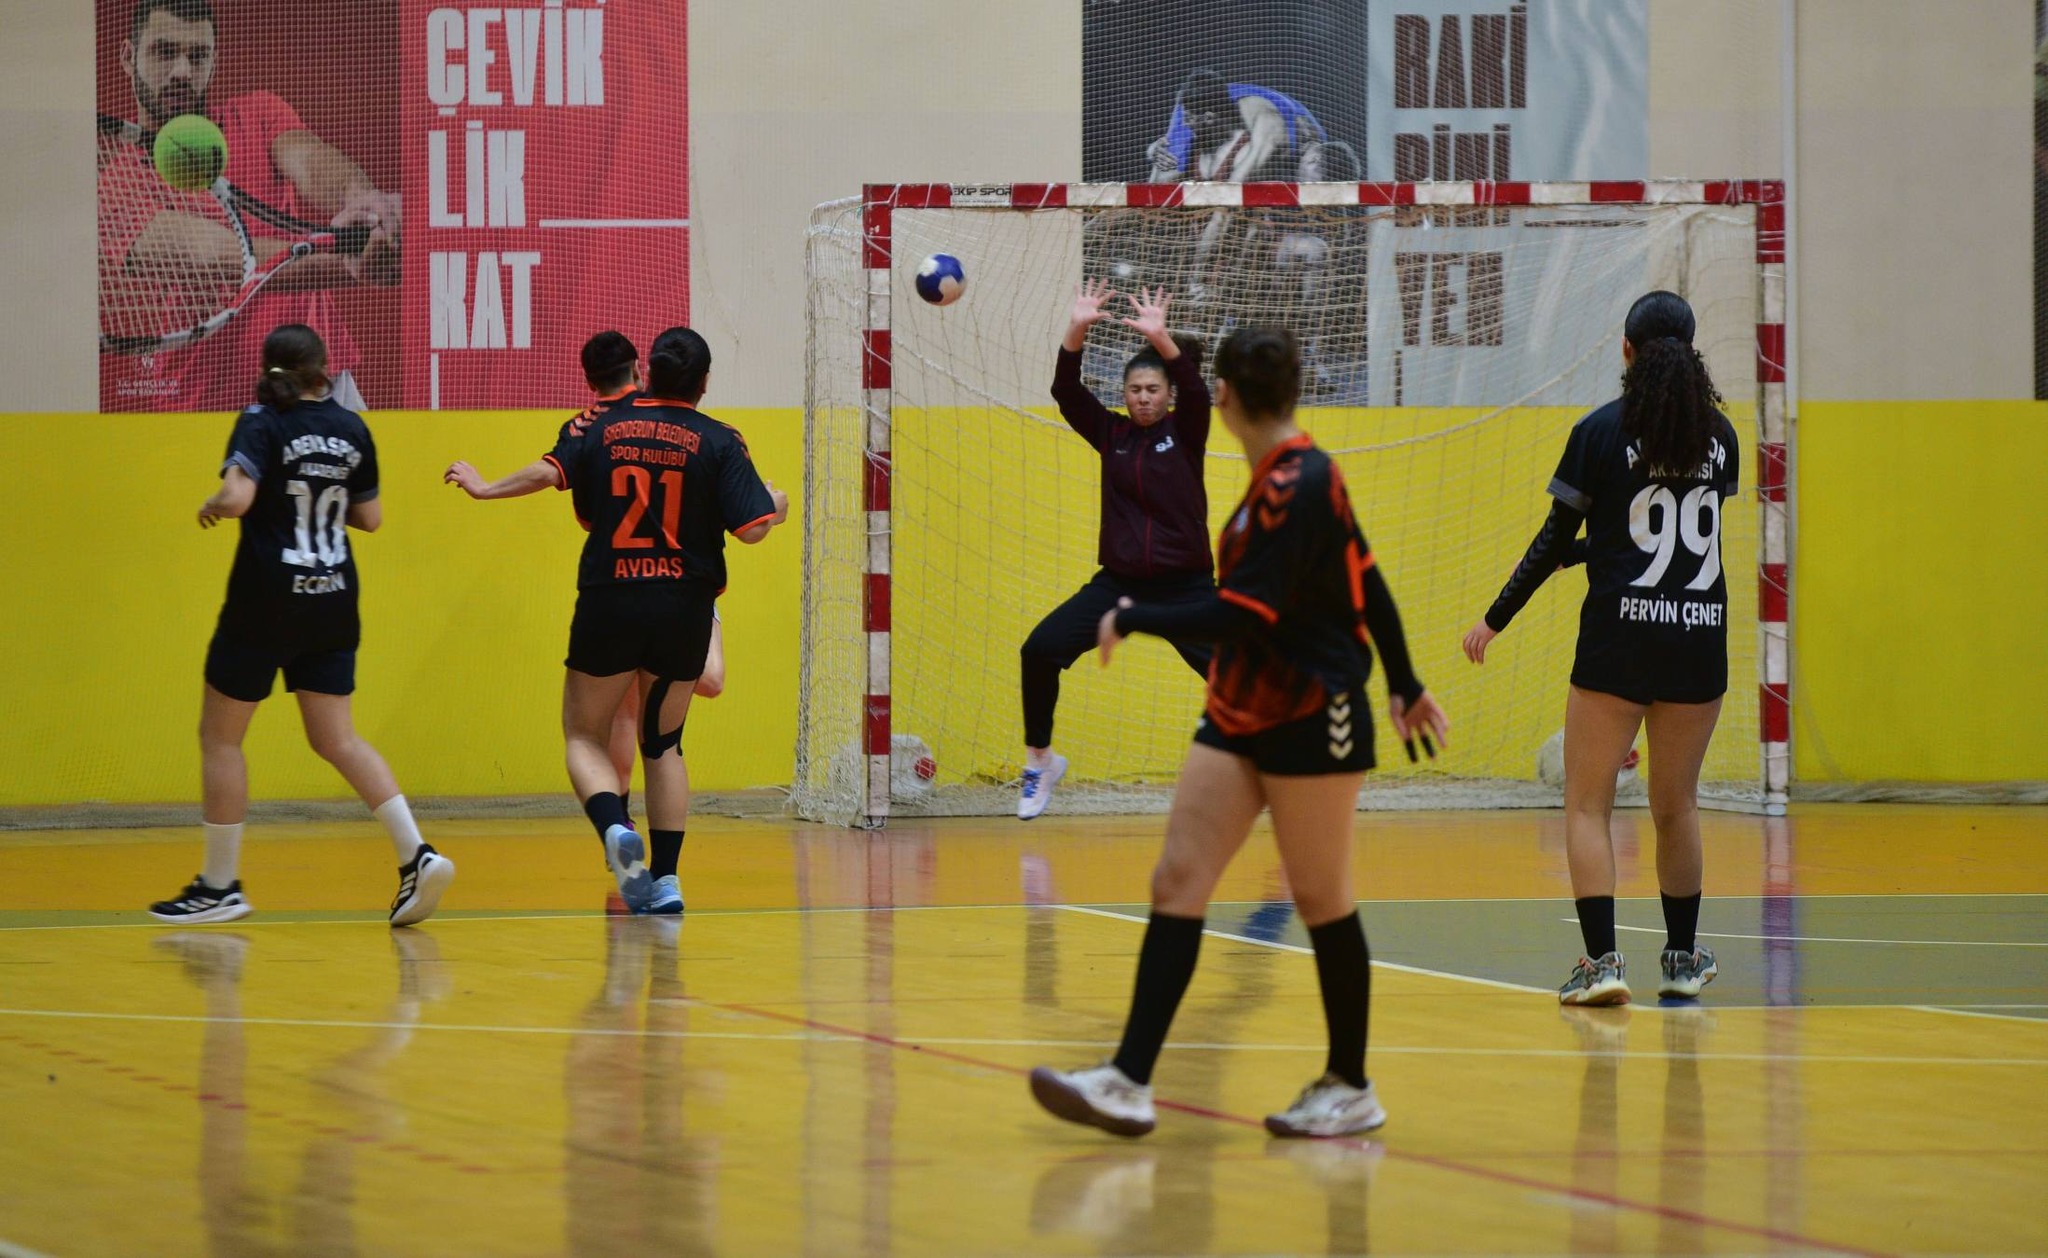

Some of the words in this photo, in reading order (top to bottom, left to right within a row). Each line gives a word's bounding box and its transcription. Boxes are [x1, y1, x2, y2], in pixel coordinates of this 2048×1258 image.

[427, 0, 604, 115] ÇEVİK
[1394, 6, 1528, 109] RAKİ
[428, 121, 526, 228] LİK
[979, 187, 1011, 196] SPOR
[430, 251, 541, 349] KAT
[1395, 252, 1503, 346] YEN
[603, 420, 657, 447] İSKENDERUN
[655, 422, 702, 455] BELEDİYESİ
[611, 445, 640, 461] SPOR
[642, 447, 687, 467] KULÜBÜ
[281, 479, 349, 568] 10
[611, 465, 684, 549] 21
[1628, 484, 1721, 591] 99
[614, 557, 684, 579] AYDAŞ
[1619, 594, 1677, 624] PERVİN
[1682, 601, 1723, 631] ÇENET
